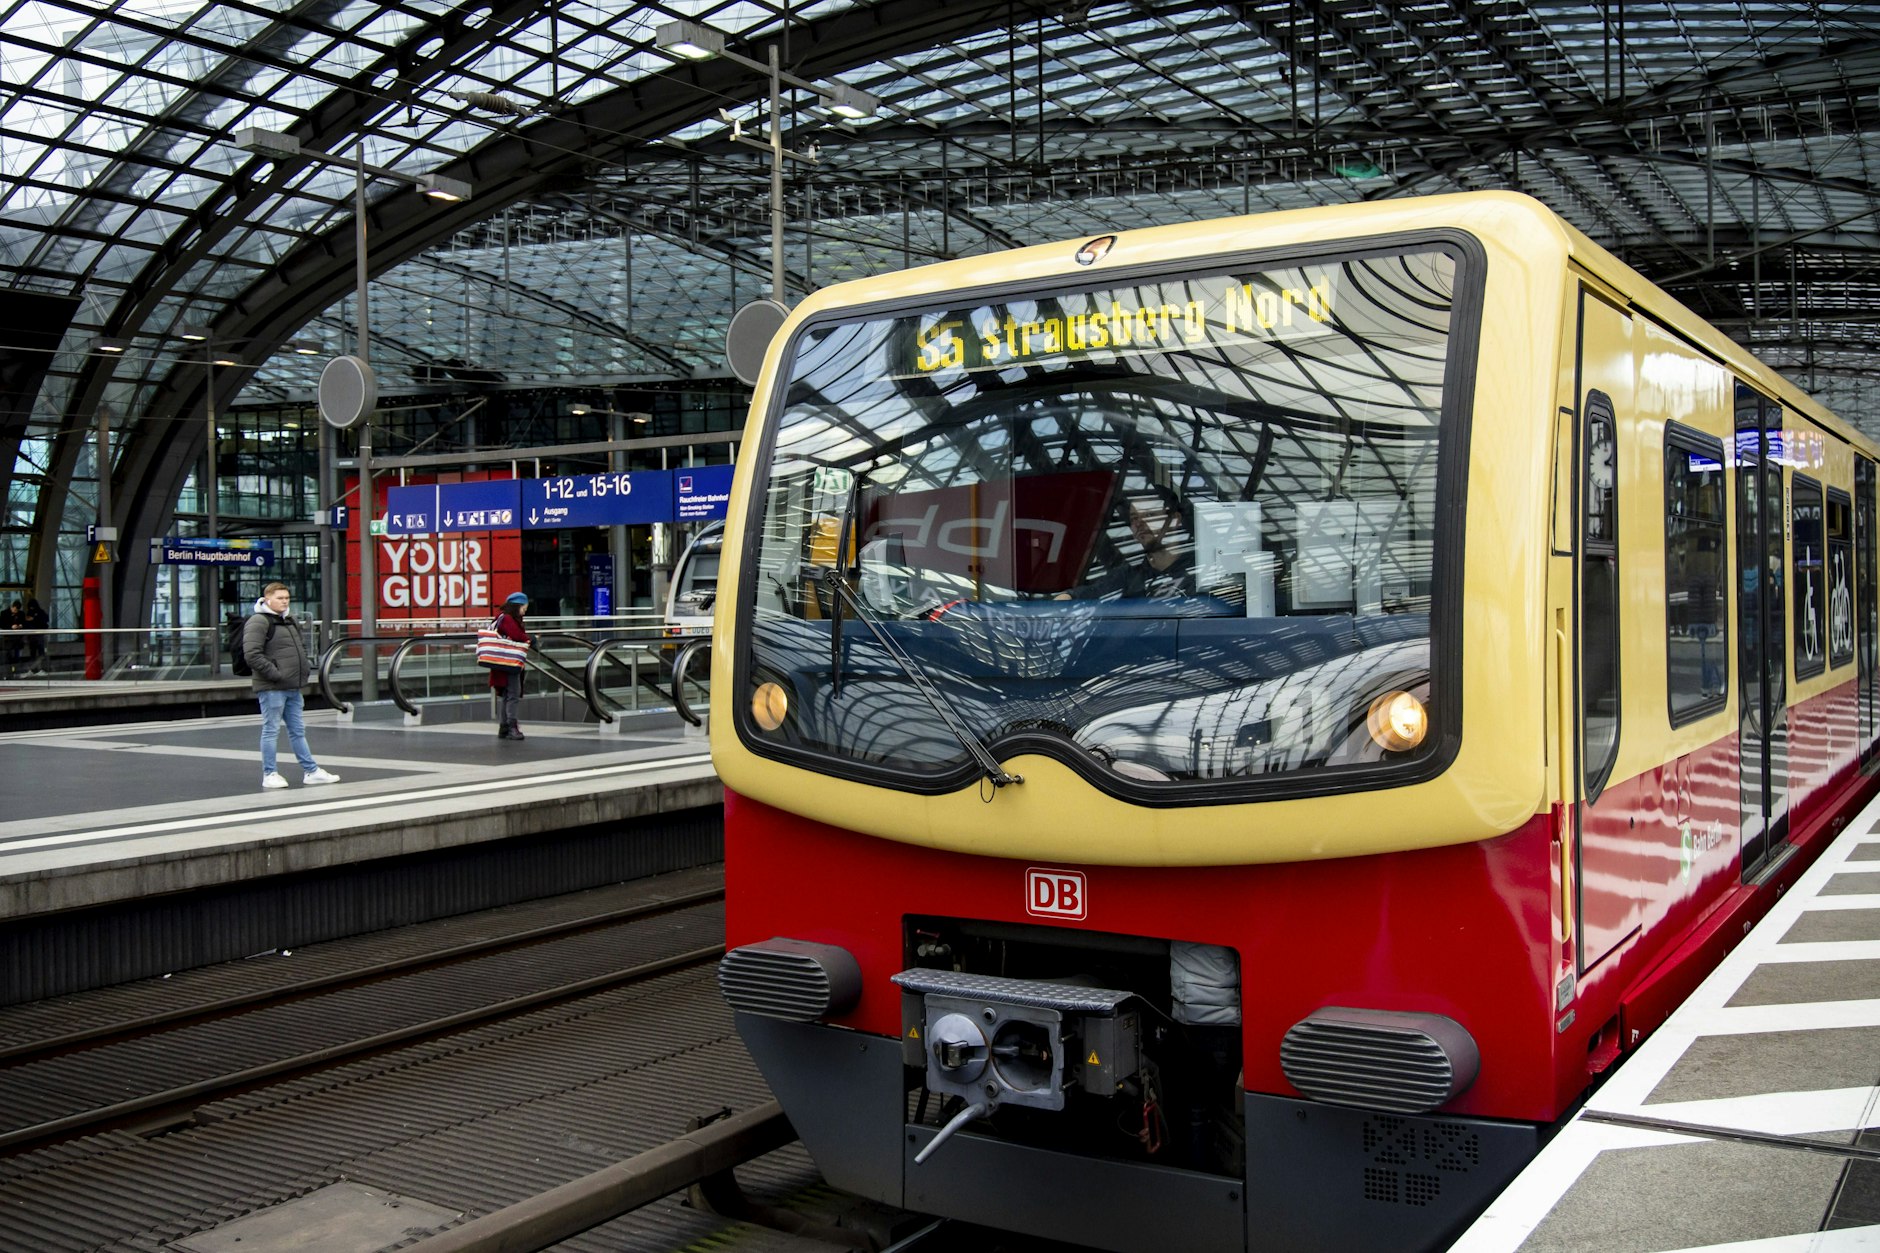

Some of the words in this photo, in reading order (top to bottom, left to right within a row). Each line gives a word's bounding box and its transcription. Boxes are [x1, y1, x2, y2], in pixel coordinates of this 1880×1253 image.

[916, 319, 965, 372] S5
[982, 299, 1206, 362] Strausberg
[1225, 274, 1331, 334] Nord
[543, 478, 574, 499] 1-12
[576, 488, 588, 498] und
[589, 474, 631, 496] 15-16
[707, 493, 729, 502] Bahnhof
[337, 506, 346, 524] F
[544, 507, 568, 516] Ausgang
[88, 525, 95, 541] F
[168, 550, 193, 560] Berlin
[195, 551, 251, 562] Hauptbahnhof
[383, 541, 482, 573] YOUR
[383, 574, 488, 607] GUIDE
[1034, 876, 1079, 911] DB
